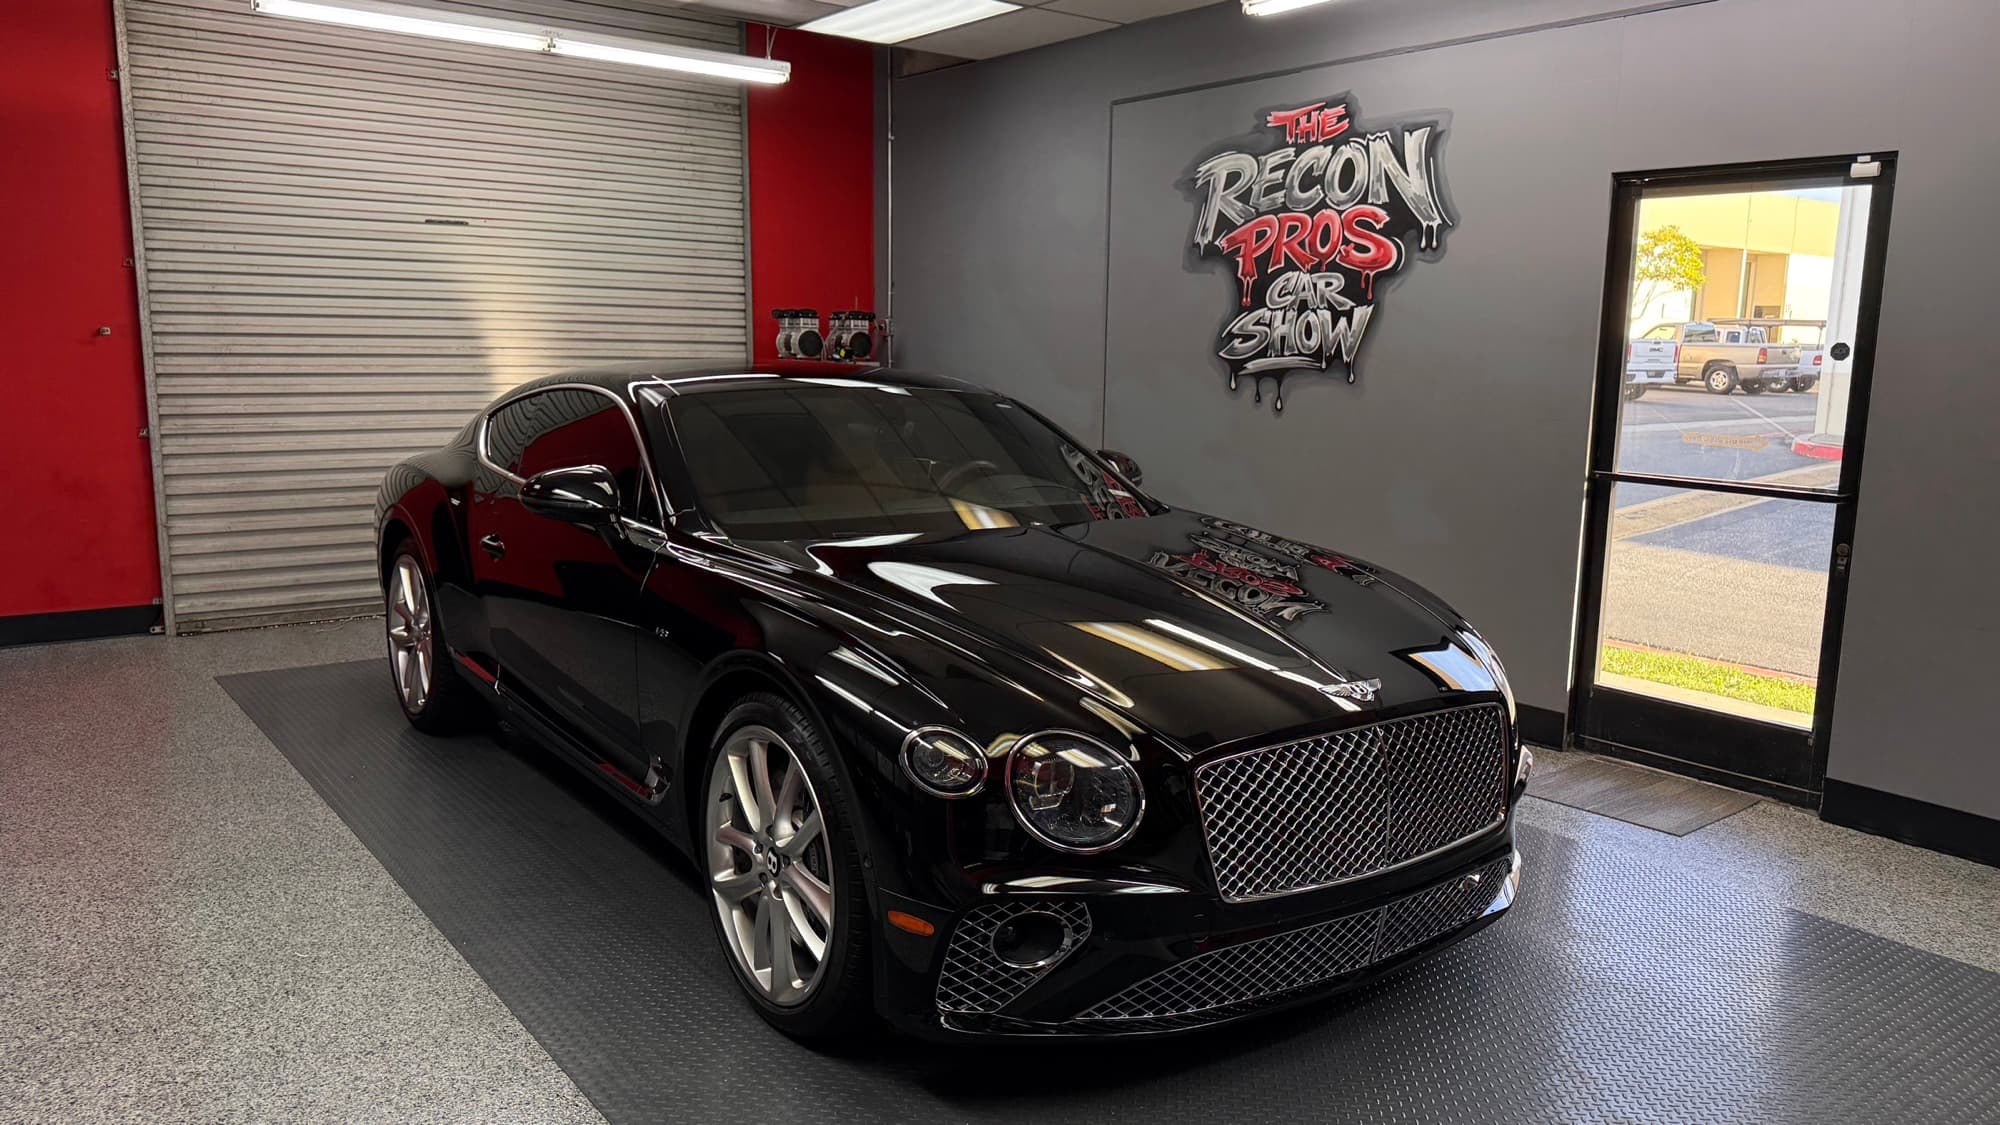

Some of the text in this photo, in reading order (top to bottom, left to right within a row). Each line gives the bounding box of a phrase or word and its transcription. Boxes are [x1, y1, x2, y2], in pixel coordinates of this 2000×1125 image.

[1267, 102, 1349, 144] THE
[1194, 127, 1443, 247] RECON
[1217, 204, 1398, 282] PROS
[1266, 271, 1356, 309] CAR
[1218, 304, 1374, 365] SHOW
